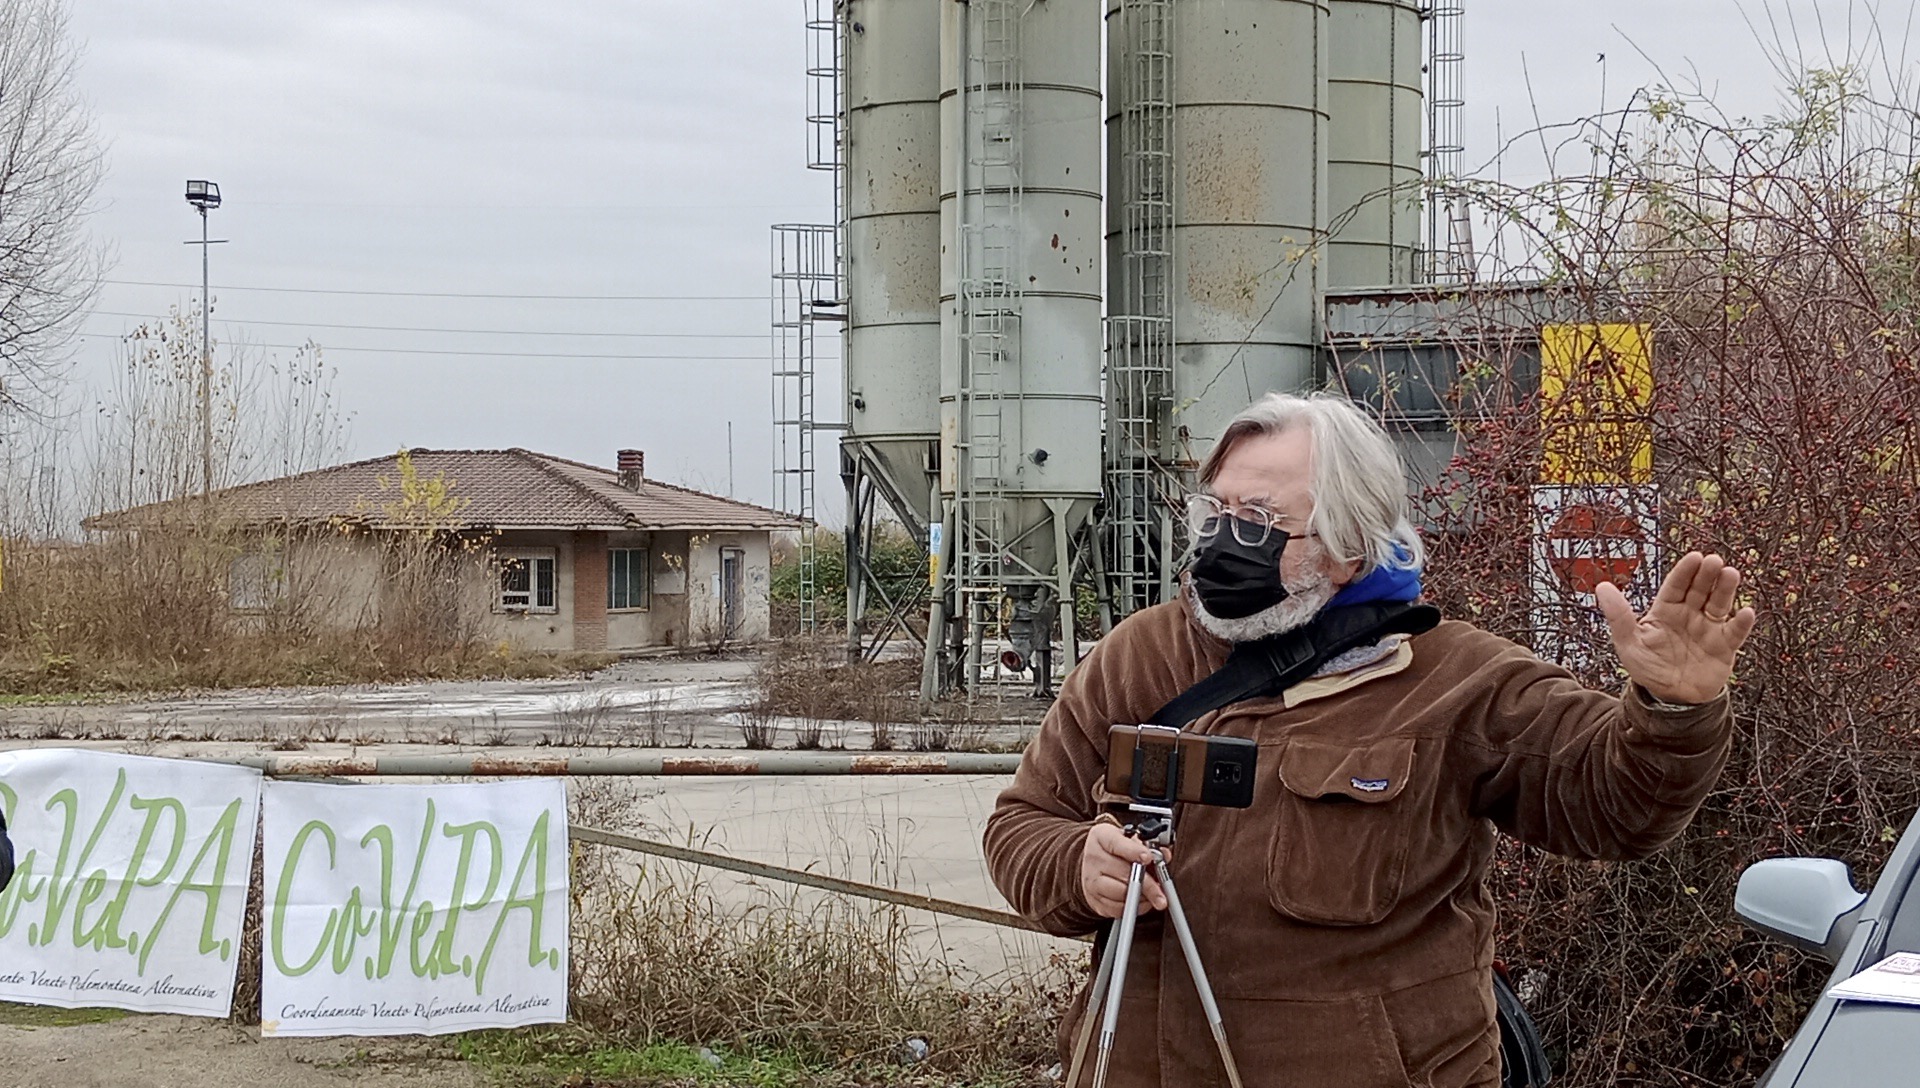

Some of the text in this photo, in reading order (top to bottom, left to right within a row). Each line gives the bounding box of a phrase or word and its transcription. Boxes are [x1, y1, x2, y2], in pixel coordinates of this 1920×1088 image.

[31, 969, 67, 988] Veneto
[68, 968, 142, 992] Pedemontana
[143, 973, 218, 999] Alternativa
[281, 993, 551, 1020] Coordinamento Veneto Pedemontana Alternativa
